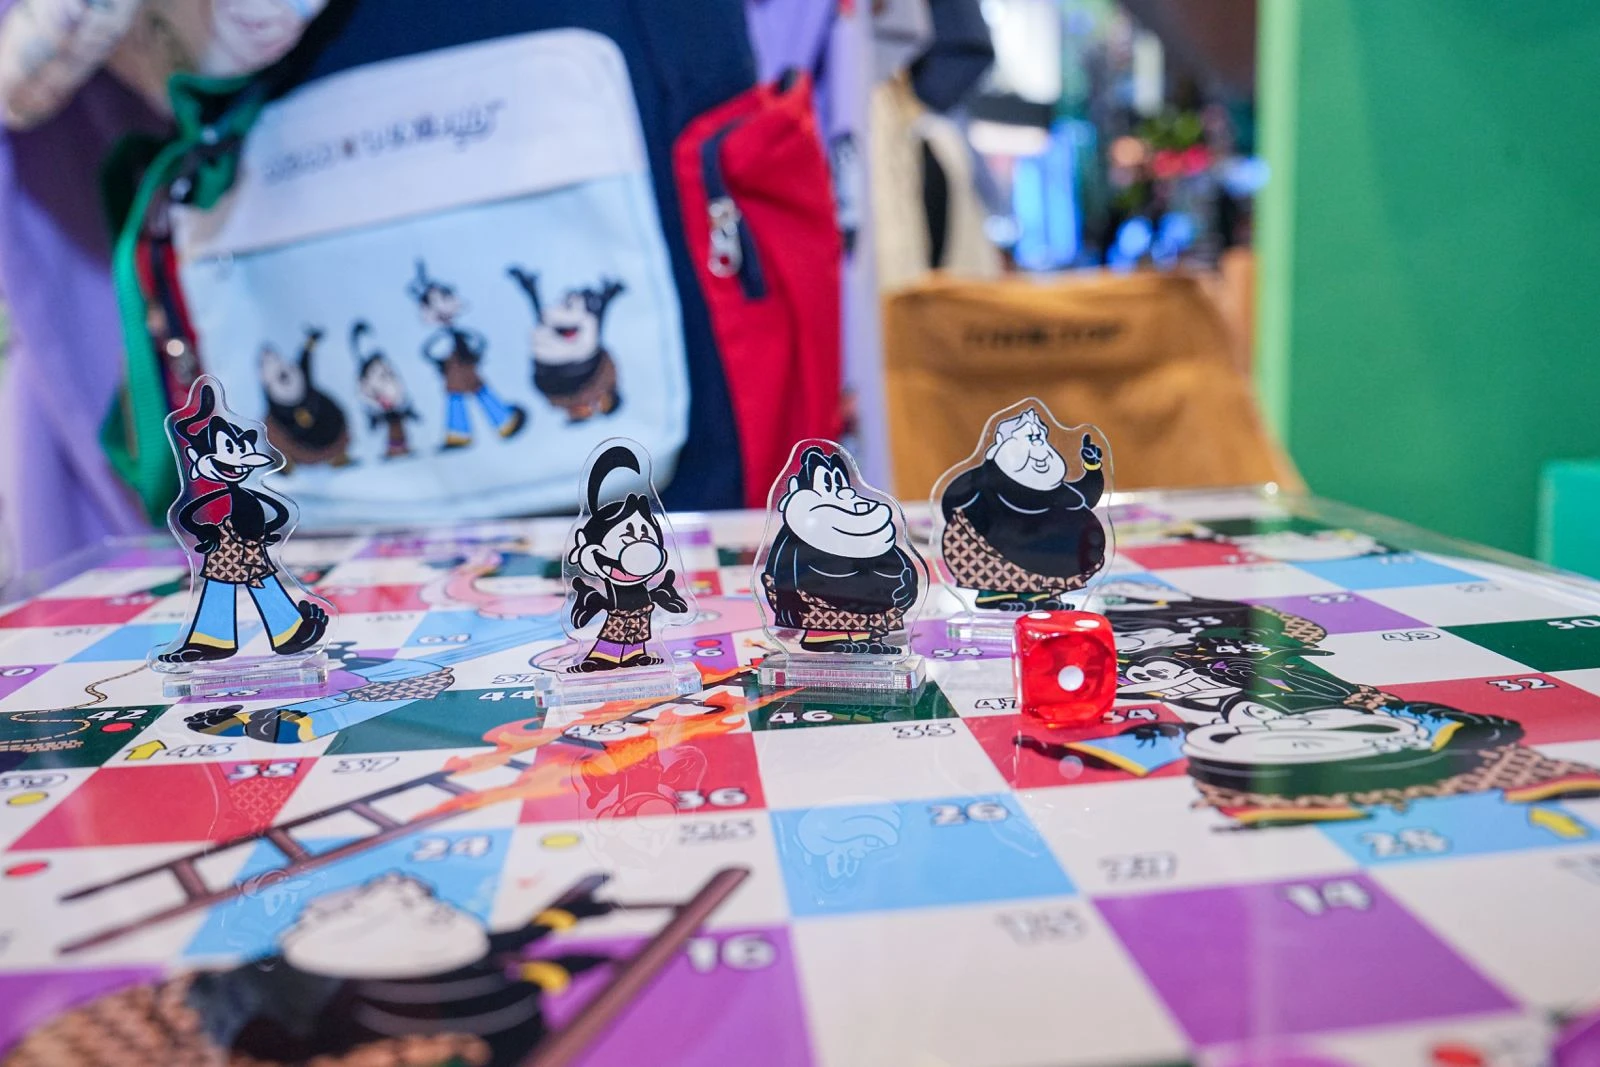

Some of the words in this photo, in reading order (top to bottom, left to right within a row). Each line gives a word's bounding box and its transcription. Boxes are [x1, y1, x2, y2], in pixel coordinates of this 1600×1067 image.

[1546, 617, 1600, 631] 50
[1381, 630, 1442, 643] 49
[672, 646, 724, 659] 56
[930, 645, 985, 659] 54
[1216, 641, 1271, 656] 48
[1486, 676, 1560, 693] 32
[479, 689, 535, 702] 44
[87, 707, 150, 722] 42
[769, 709, 835, 725] 46
[892, 722, 956, 740] 35
[332, 756, 400, 774] 37
[677, 786, 749, 808] 36
[927, 801, 1010, 828] 26
[410, 834, 492, 862] 24
